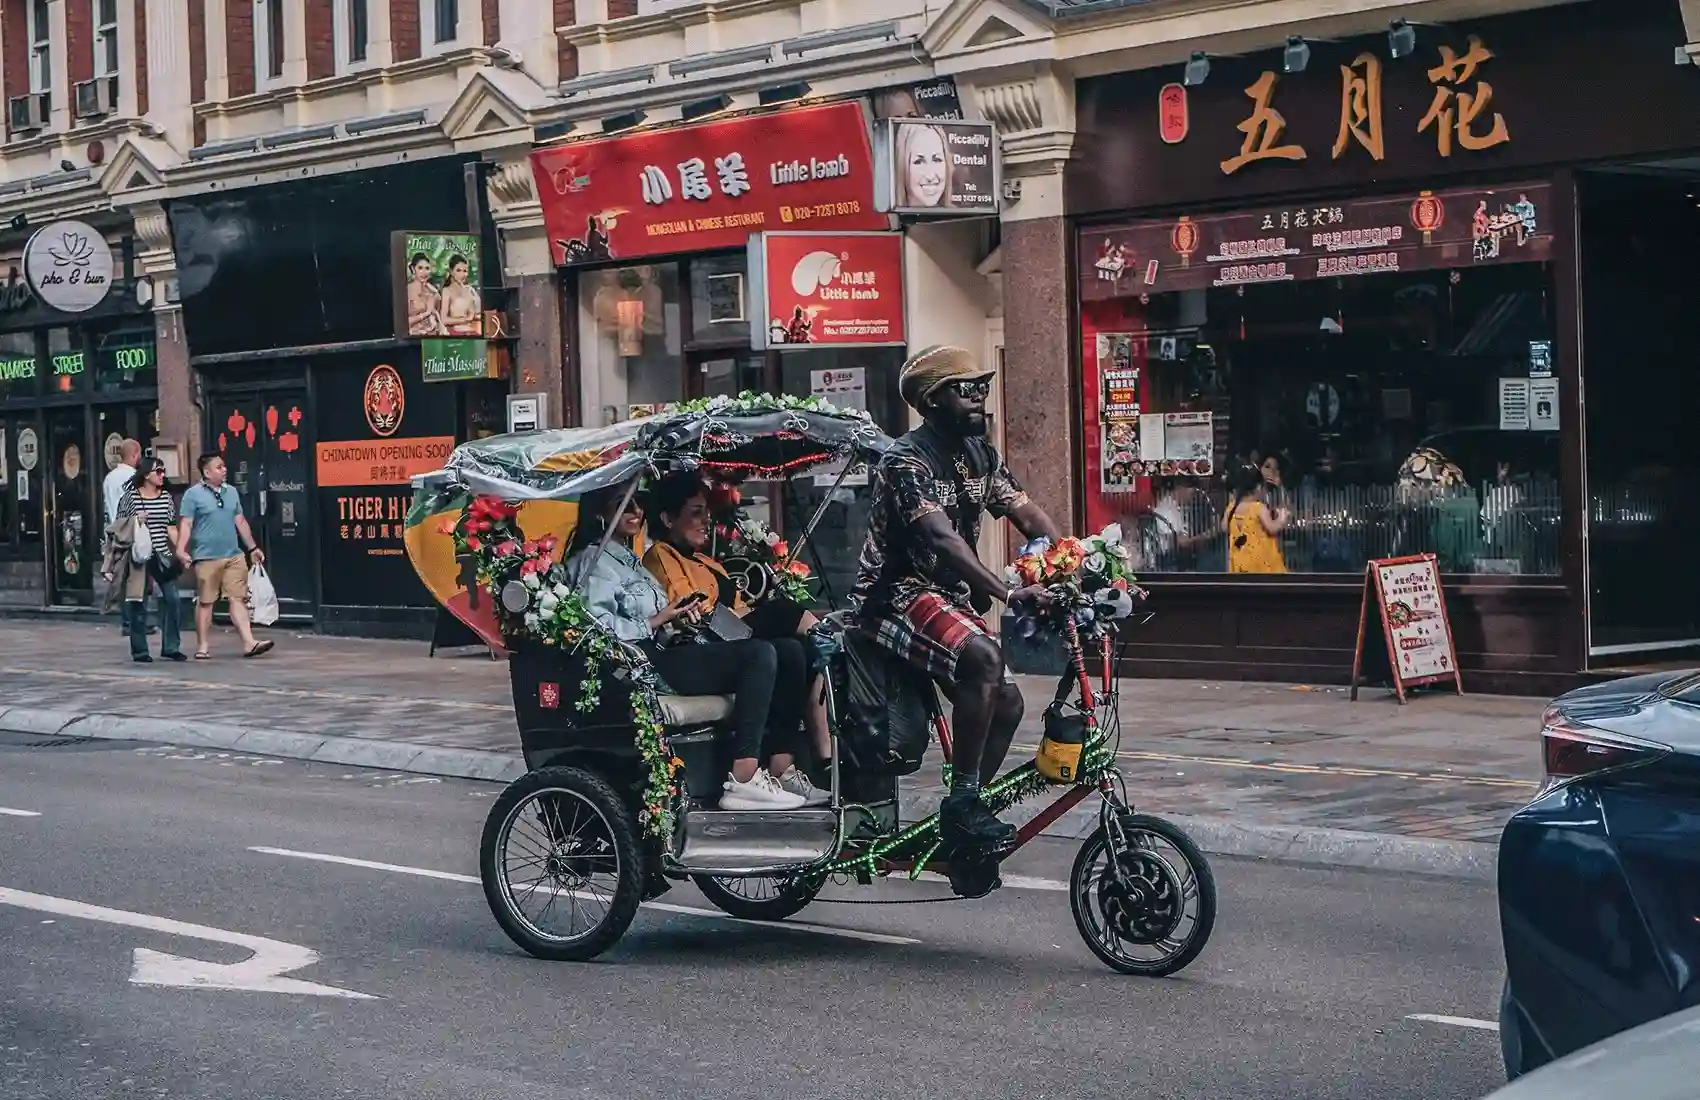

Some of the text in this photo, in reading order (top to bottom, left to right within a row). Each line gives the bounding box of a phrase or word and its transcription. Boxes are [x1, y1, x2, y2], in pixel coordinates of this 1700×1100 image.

[914, 81, 956, 100] Piccadilly
[1220, 34, 1510, 175] 五月花
[948, 133, 989, 147] Piccadilly
[770, 153, 849, 184] Little lamb
[953, 154, 987, 165] Dental
[646, 220, 688, 236] MONGOLIAN
[688, 219, 695, 232] &
[696, 216, 724, 231] CHINESE
[408, 237, 477, 254] Thai Massage
[41, 268, 105, 288] pho & bun
[820, 287, 879, 300] Little lamb
[52, 353, 84, 375] STREET
[116, 348, 146, 369] FOOD
[424, 353, 487, 376] Thai Massage
[322, 443, 453, 462] CHINATOWN OPENING SOON
[337, 496, 384, 520] TIGER
